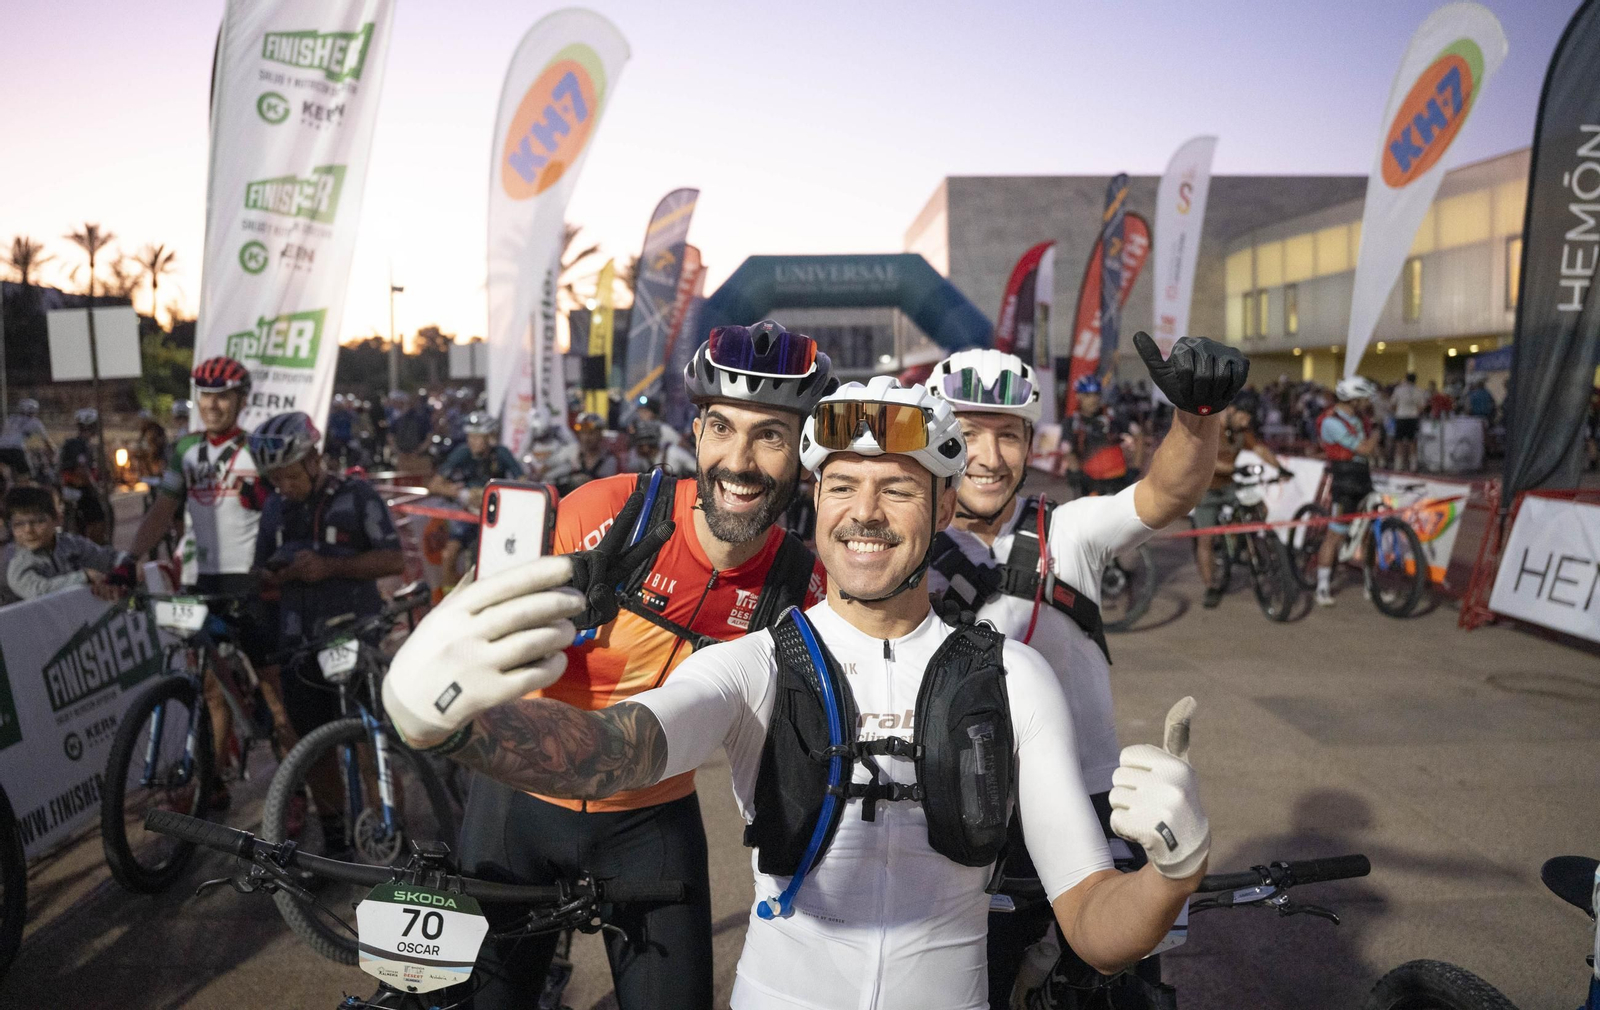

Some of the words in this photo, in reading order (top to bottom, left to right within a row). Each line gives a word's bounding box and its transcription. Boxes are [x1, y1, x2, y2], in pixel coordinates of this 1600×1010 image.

[247, 392, 296, 409] ERN
[635, 590, 665, 606] NISHER
[47, 611, 154, 707] FINISHER
[401, 907, 445, 941] 70
[396, 941, 440, 956] OSCAR
